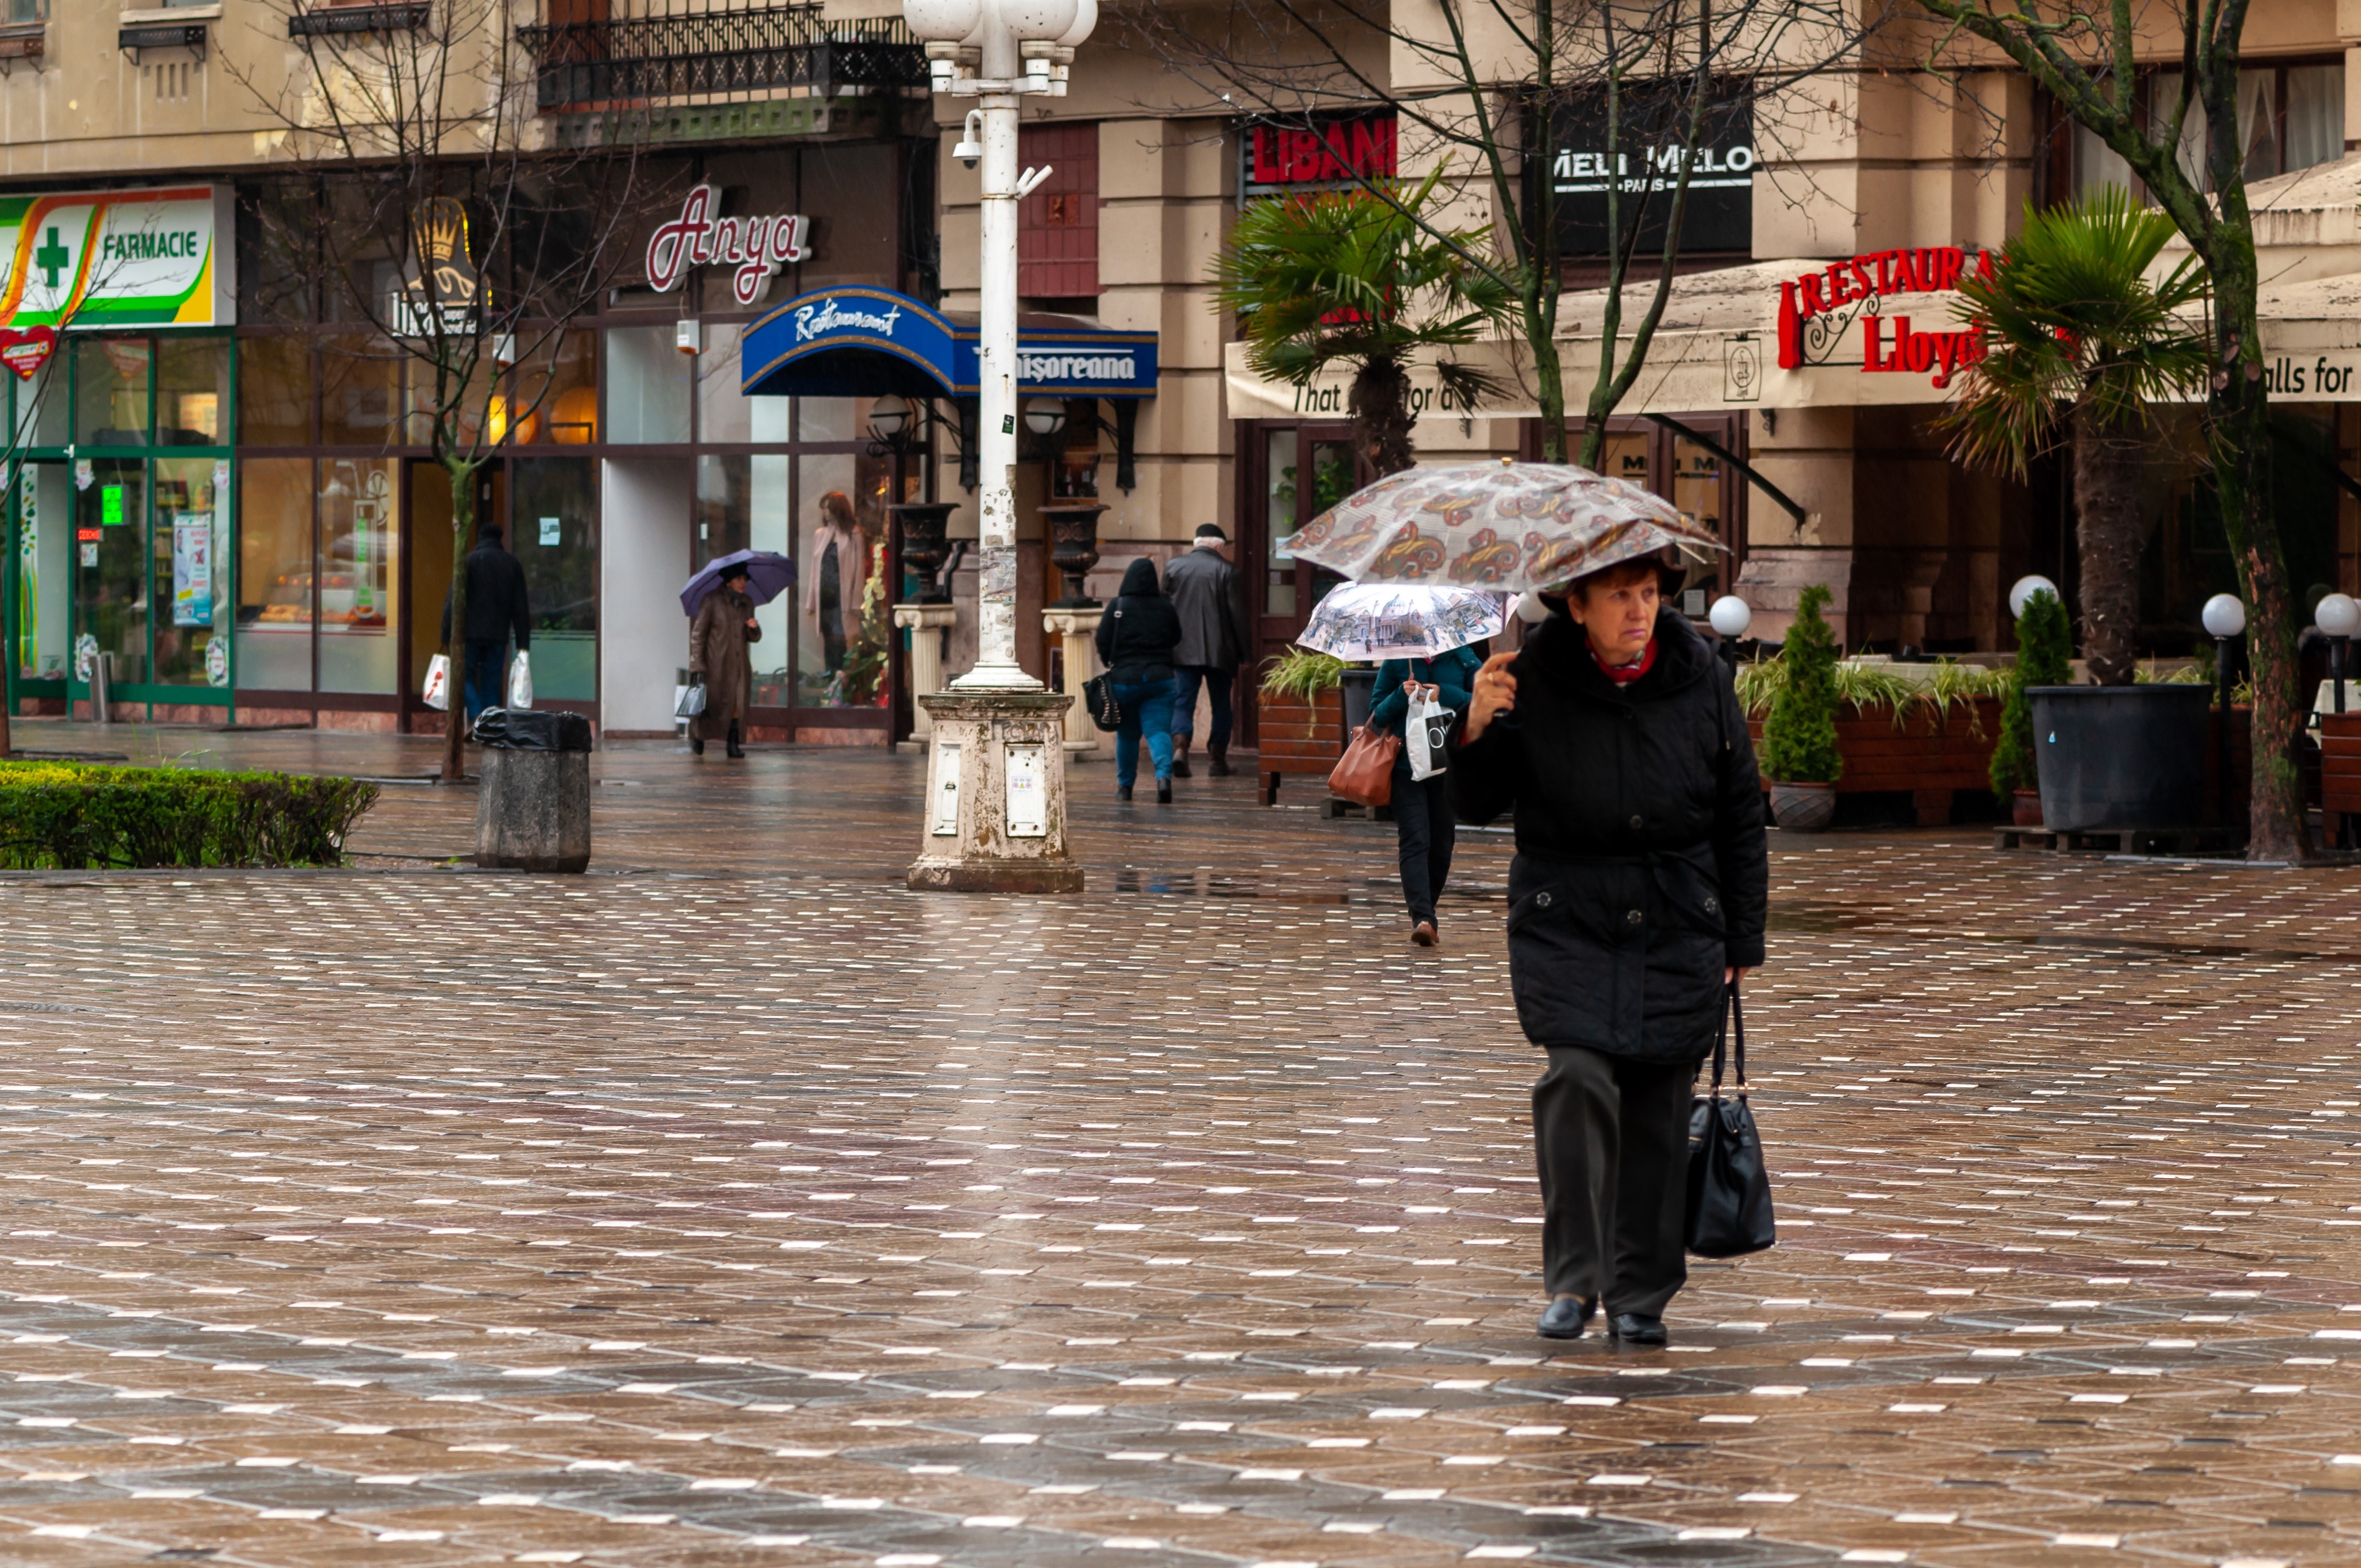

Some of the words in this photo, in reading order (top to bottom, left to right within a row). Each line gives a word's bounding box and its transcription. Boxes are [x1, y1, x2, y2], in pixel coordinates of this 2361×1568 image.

[104, 231, 197, 260] FARMACIE
[646, 183, 812, 304] Anya
[1798, 247, 2010, 319] RESTAURA
[795, 297, 901, 341] Restaurant
[1860, 315, 1989, 389] Lloyd
[1292, 382, 1341, 412] That
[1405, 387, 1433, 411] or
[2265, 357, 2306, 393] alls
[2315, 357, 2353, 393] for
